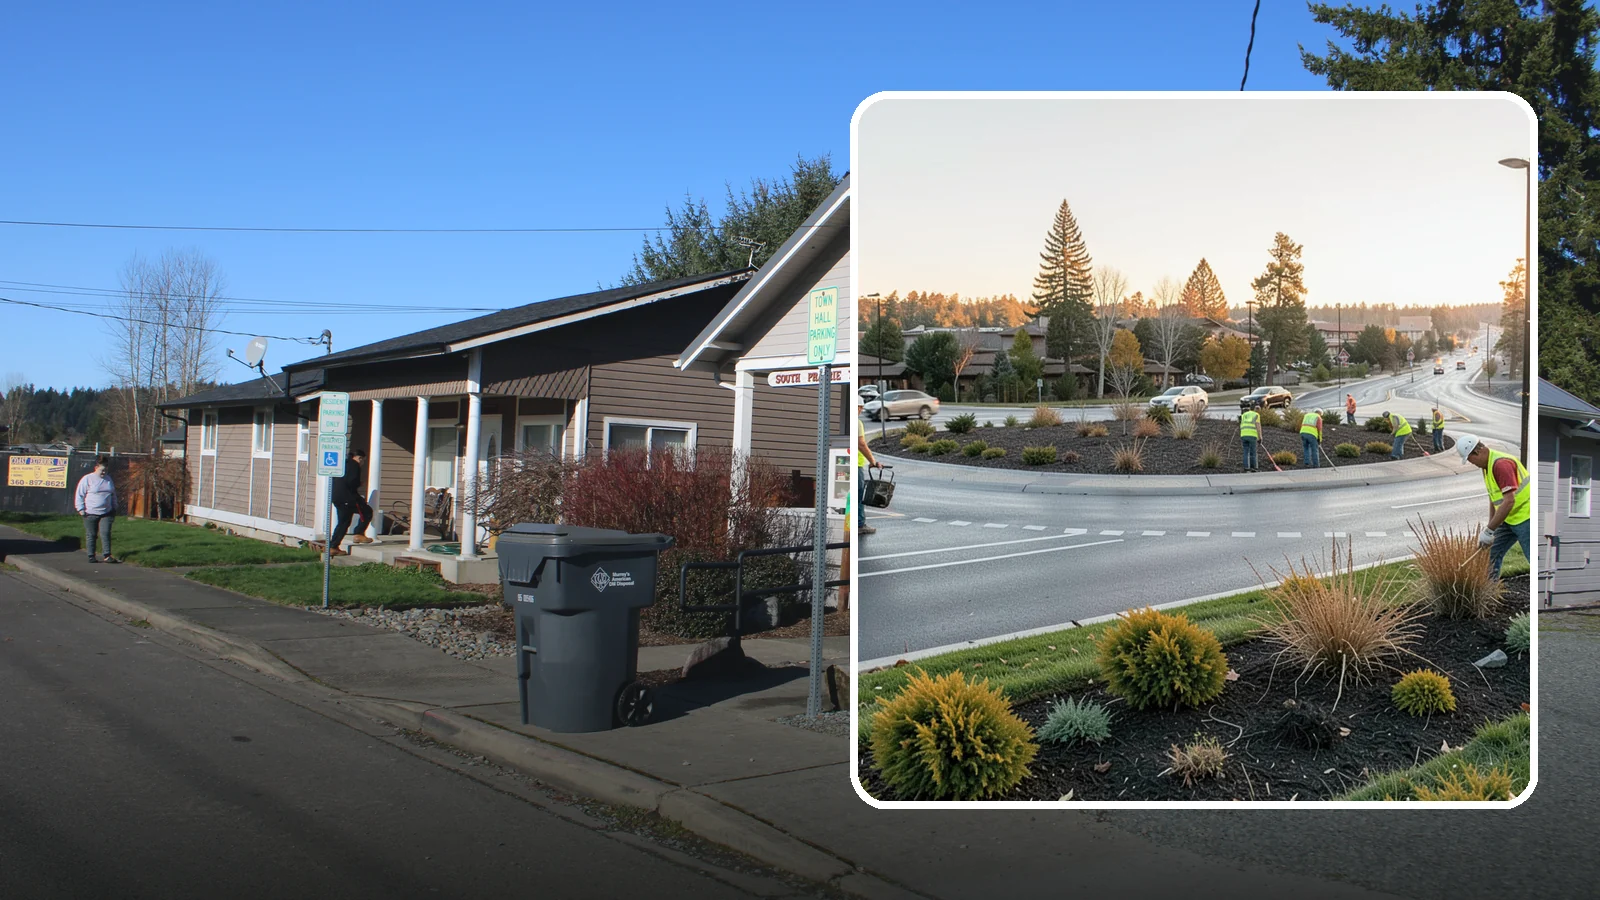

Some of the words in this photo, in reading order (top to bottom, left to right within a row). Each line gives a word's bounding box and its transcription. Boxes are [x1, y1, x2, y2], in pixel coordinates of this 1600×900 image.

[815, 294, 833, 308] TOWN
[814, 311, 831, 324] HALL
[810, 326, 836, 340] PARKING
[813, 343, 831, 357] ONLY
[775, 373, 801, 384] SOUTH
